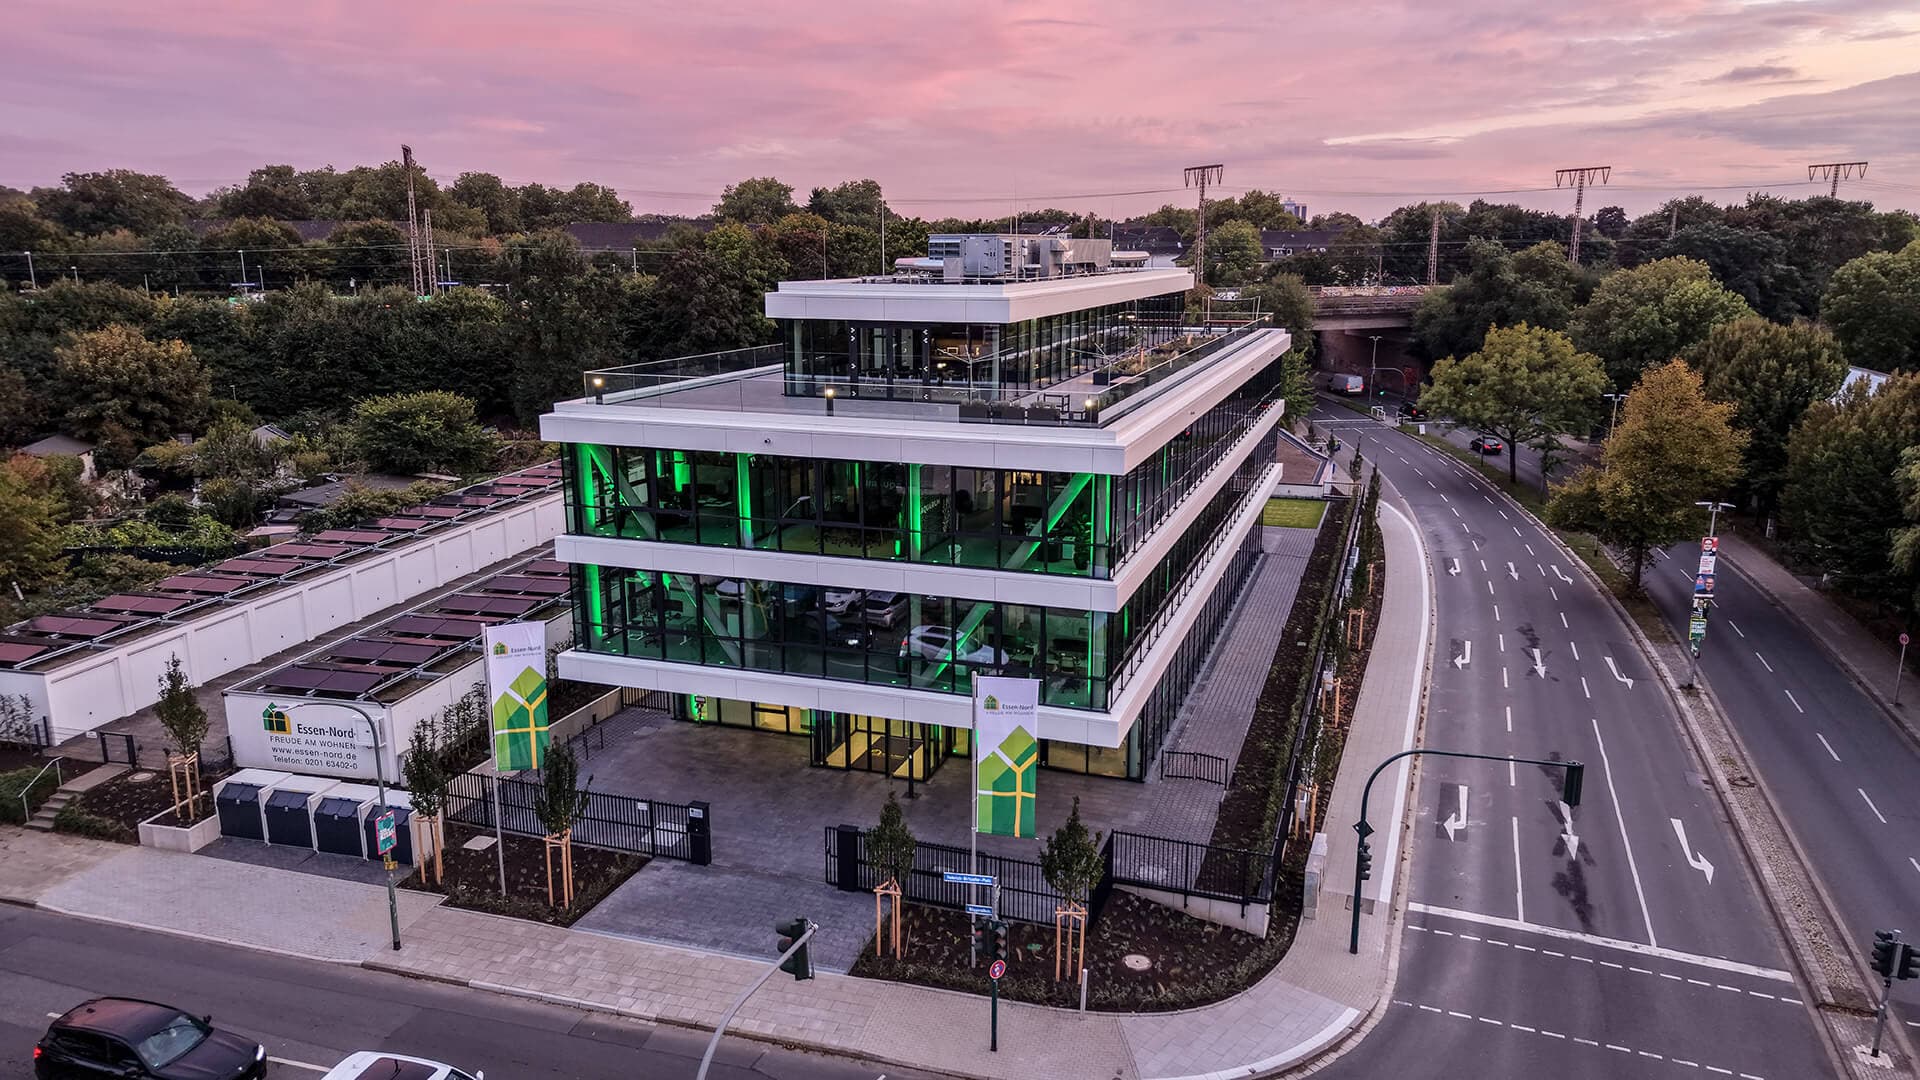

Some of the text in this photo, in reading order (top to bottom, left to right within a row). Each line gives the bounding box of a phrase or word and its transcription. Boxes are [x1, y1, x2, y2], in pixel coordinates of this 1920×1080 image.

[297, 723, 354, 738] Essen-Nord
[270, 735, 356, 750] FREUDE AM WOHNEN
[272, 747, 356, 761] www.essen-nord.de
[273, 755, 358, 770] Telefon: 0201 63402-0
